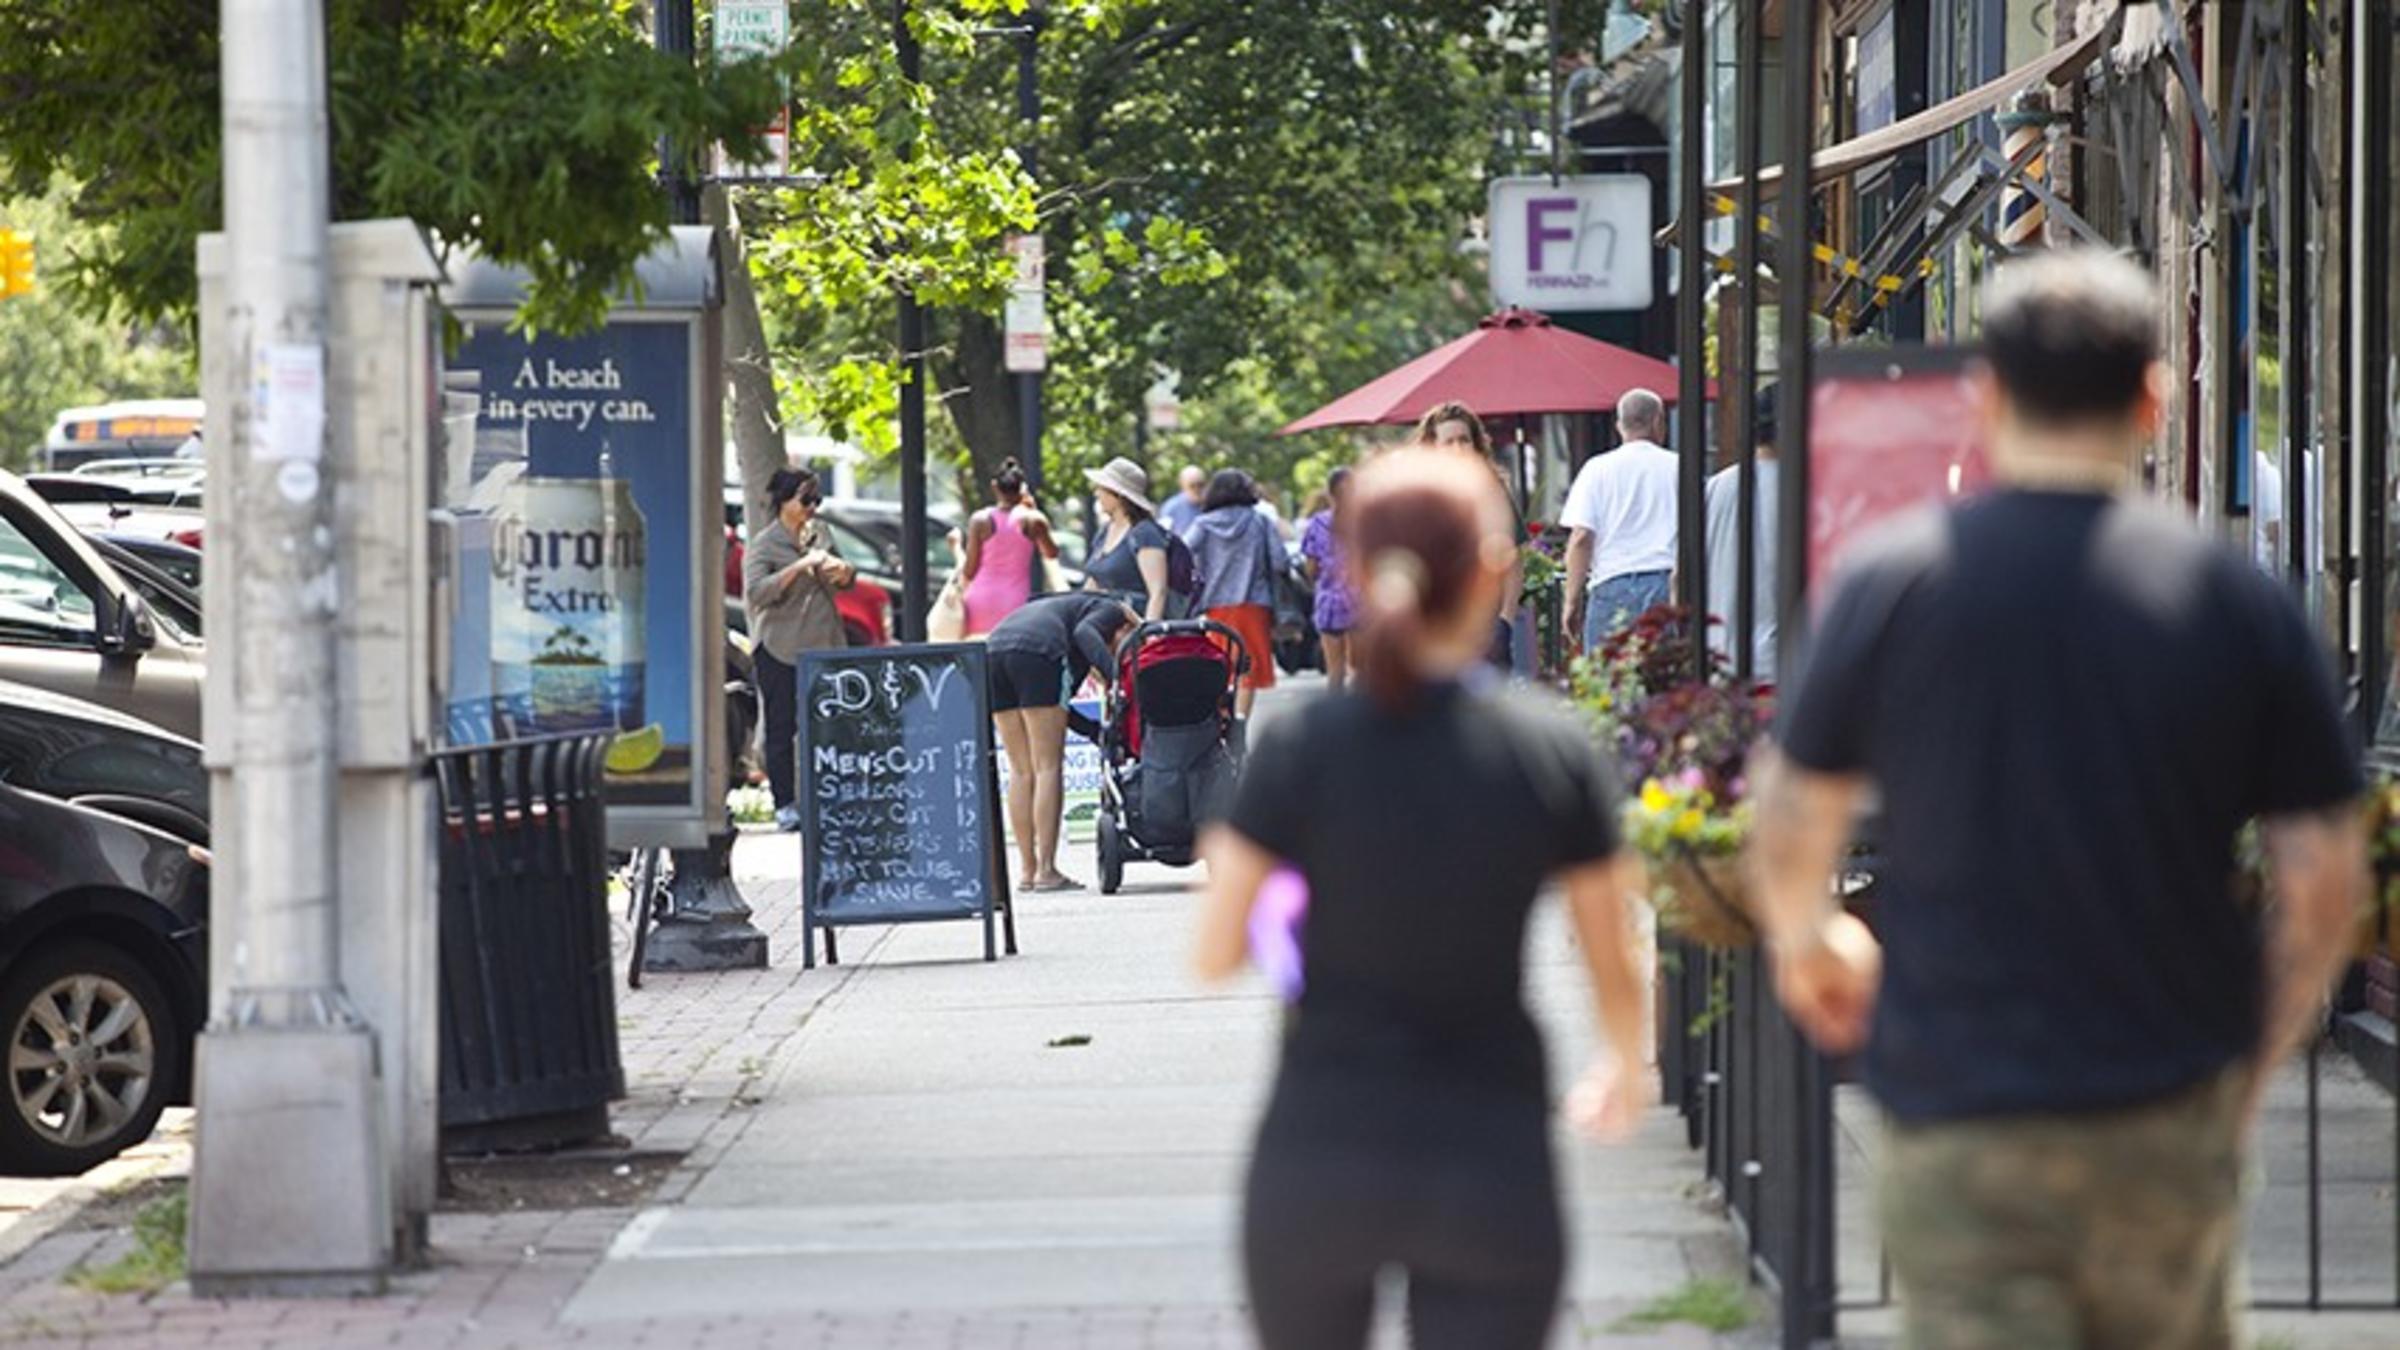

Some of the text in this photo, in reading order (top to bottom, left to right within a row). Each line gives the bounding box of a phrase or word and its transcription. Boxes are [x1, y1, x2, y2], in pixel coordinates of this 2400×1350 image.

[1527, 198, 1618, 272] Fh
[513, 357, 621, 389] A beach
[489, 391, 656, 431] in every can.
[523, 577, 614, 613] Extra
[818, 660, 957, 718] D & V
[953, 740, 976, 771] 17
